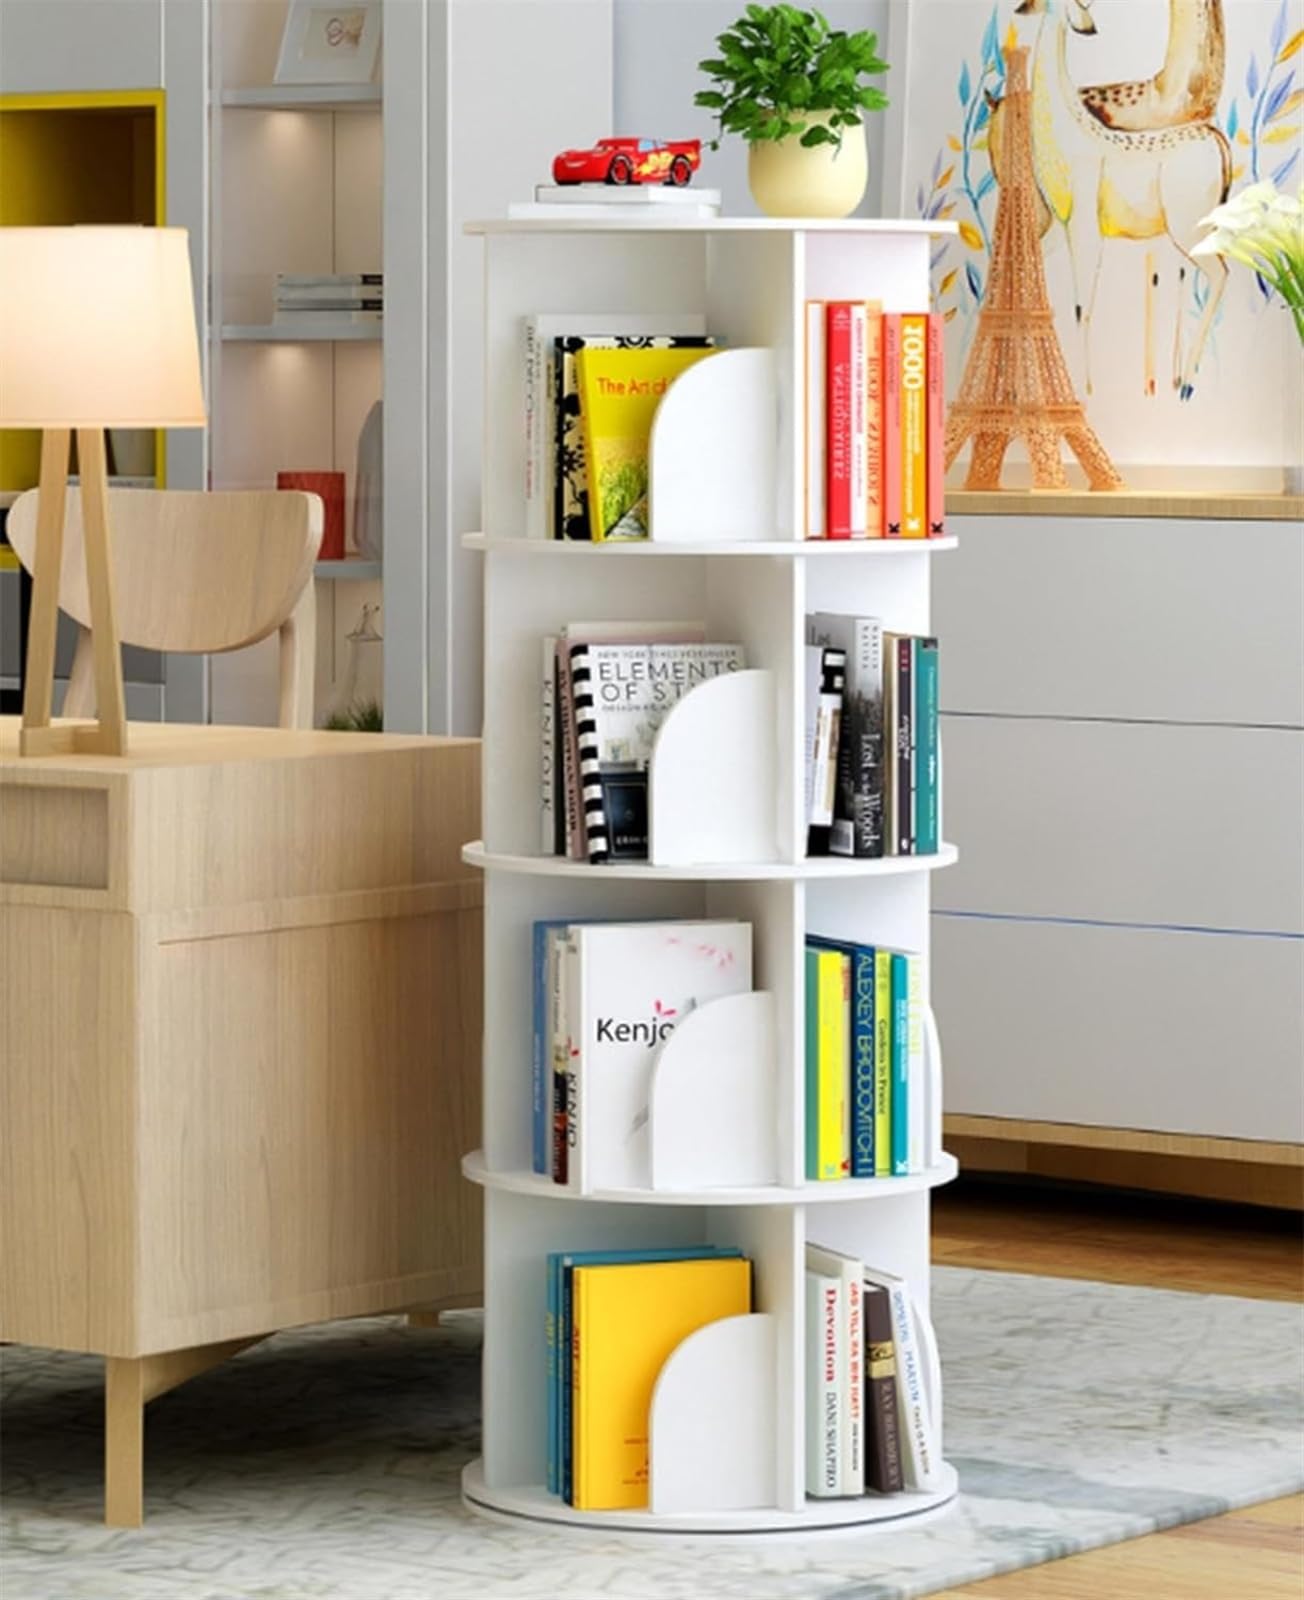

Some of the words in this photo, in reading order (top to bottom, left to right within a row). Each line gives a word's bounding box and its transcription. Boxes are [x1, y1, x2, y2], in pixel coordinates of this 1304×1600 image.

[903, 325, 922, 390] 1000
[597, 377, 625, 394] The
[629, 377, 650, 394] Art
[598, 659, 741, 681] ELEMENTS
[600, 682, 638, 702] OF
[543, 679, 552, 810] KINFOLK
[861, 734, 880, 768] Lost
[861, 793, 881, 848] Woods
[857, 954, 872, 1030] ALEXEY
[878, 1018, 887, 1064] Gardens
[878, 1080, 887, 1115] France
[825, 1289, 836, 1383] Devotion
[826, 1392, 836, 1425] DANI
[826, 1428, 836, 1488] SHAPIRO
